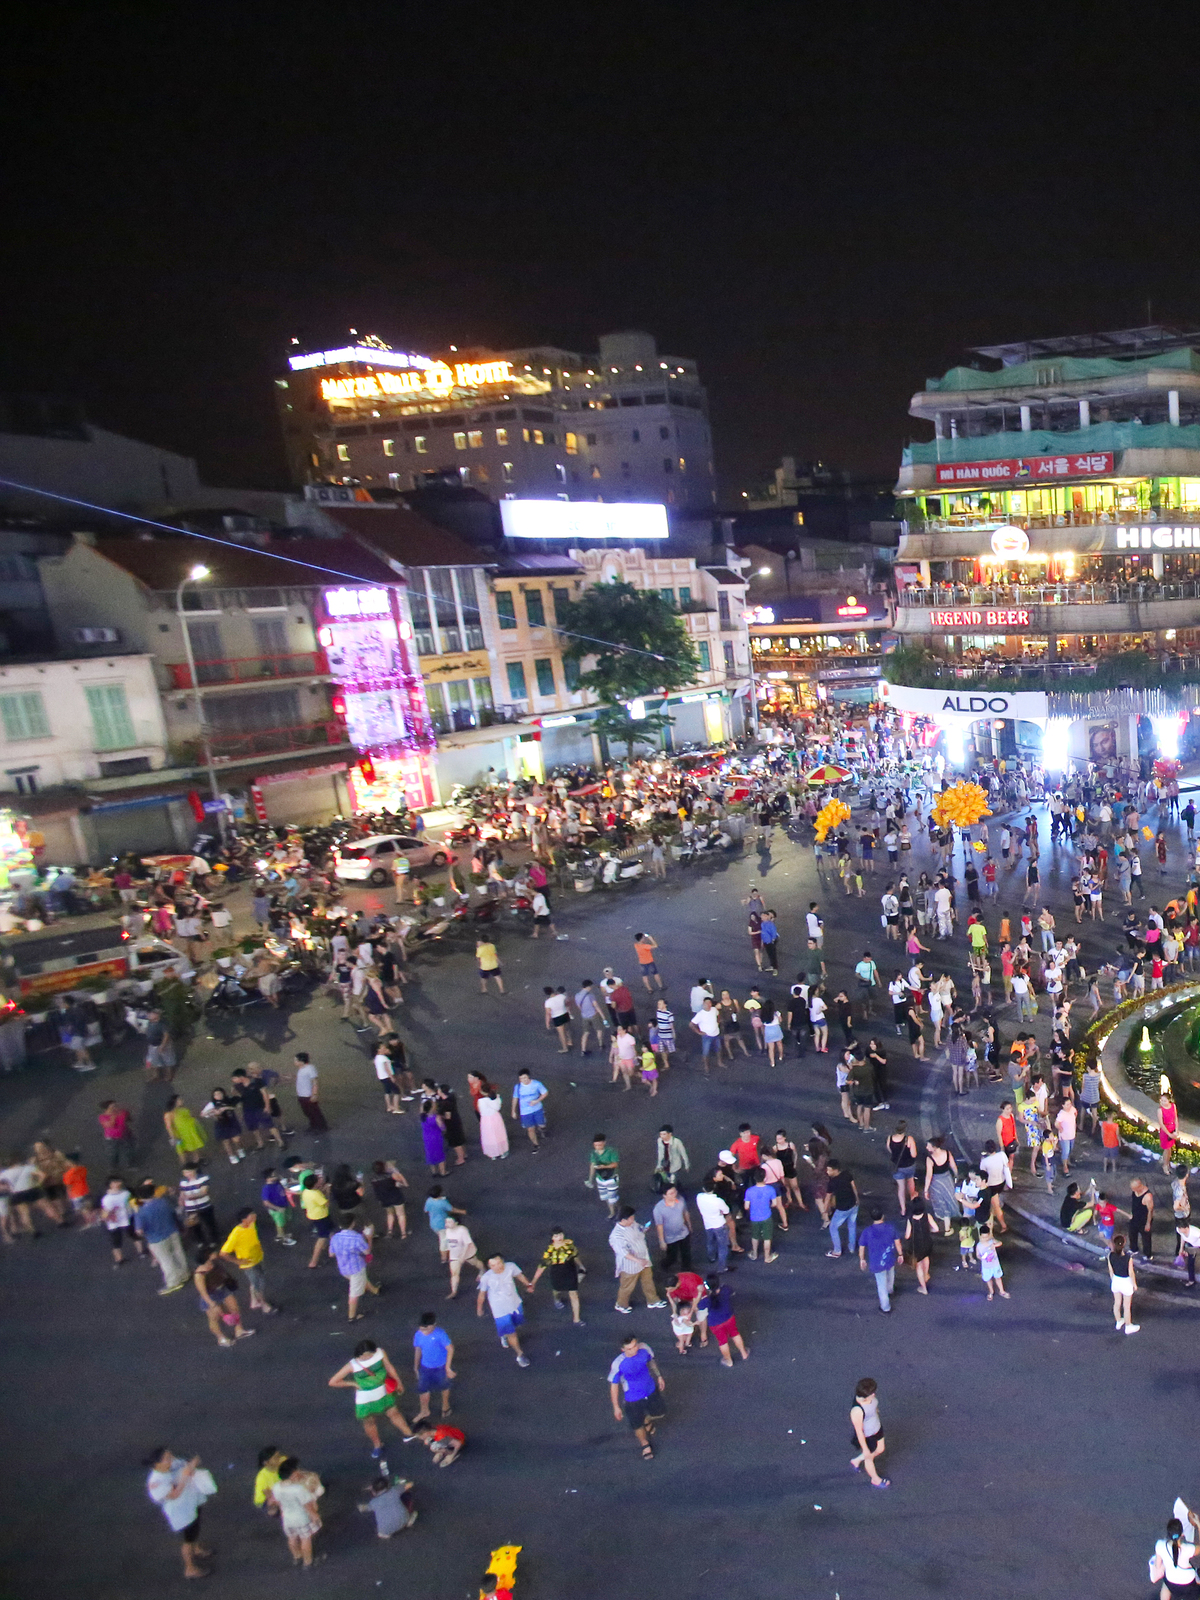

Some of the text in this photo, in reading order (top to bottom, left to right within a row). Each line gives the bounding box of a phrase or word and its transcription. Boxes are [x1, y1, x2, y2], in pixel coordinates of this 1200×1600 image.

[454, 361, 516, 387] HOTEL
[939, 462, 1011, 480] MÌ HÀN QUỐC
[1037, 455, 1109, 475] 서울 식당
[930, 609, 1030, 626] LEGEND BEER
[942, 696, 1009, 713] ALDO
